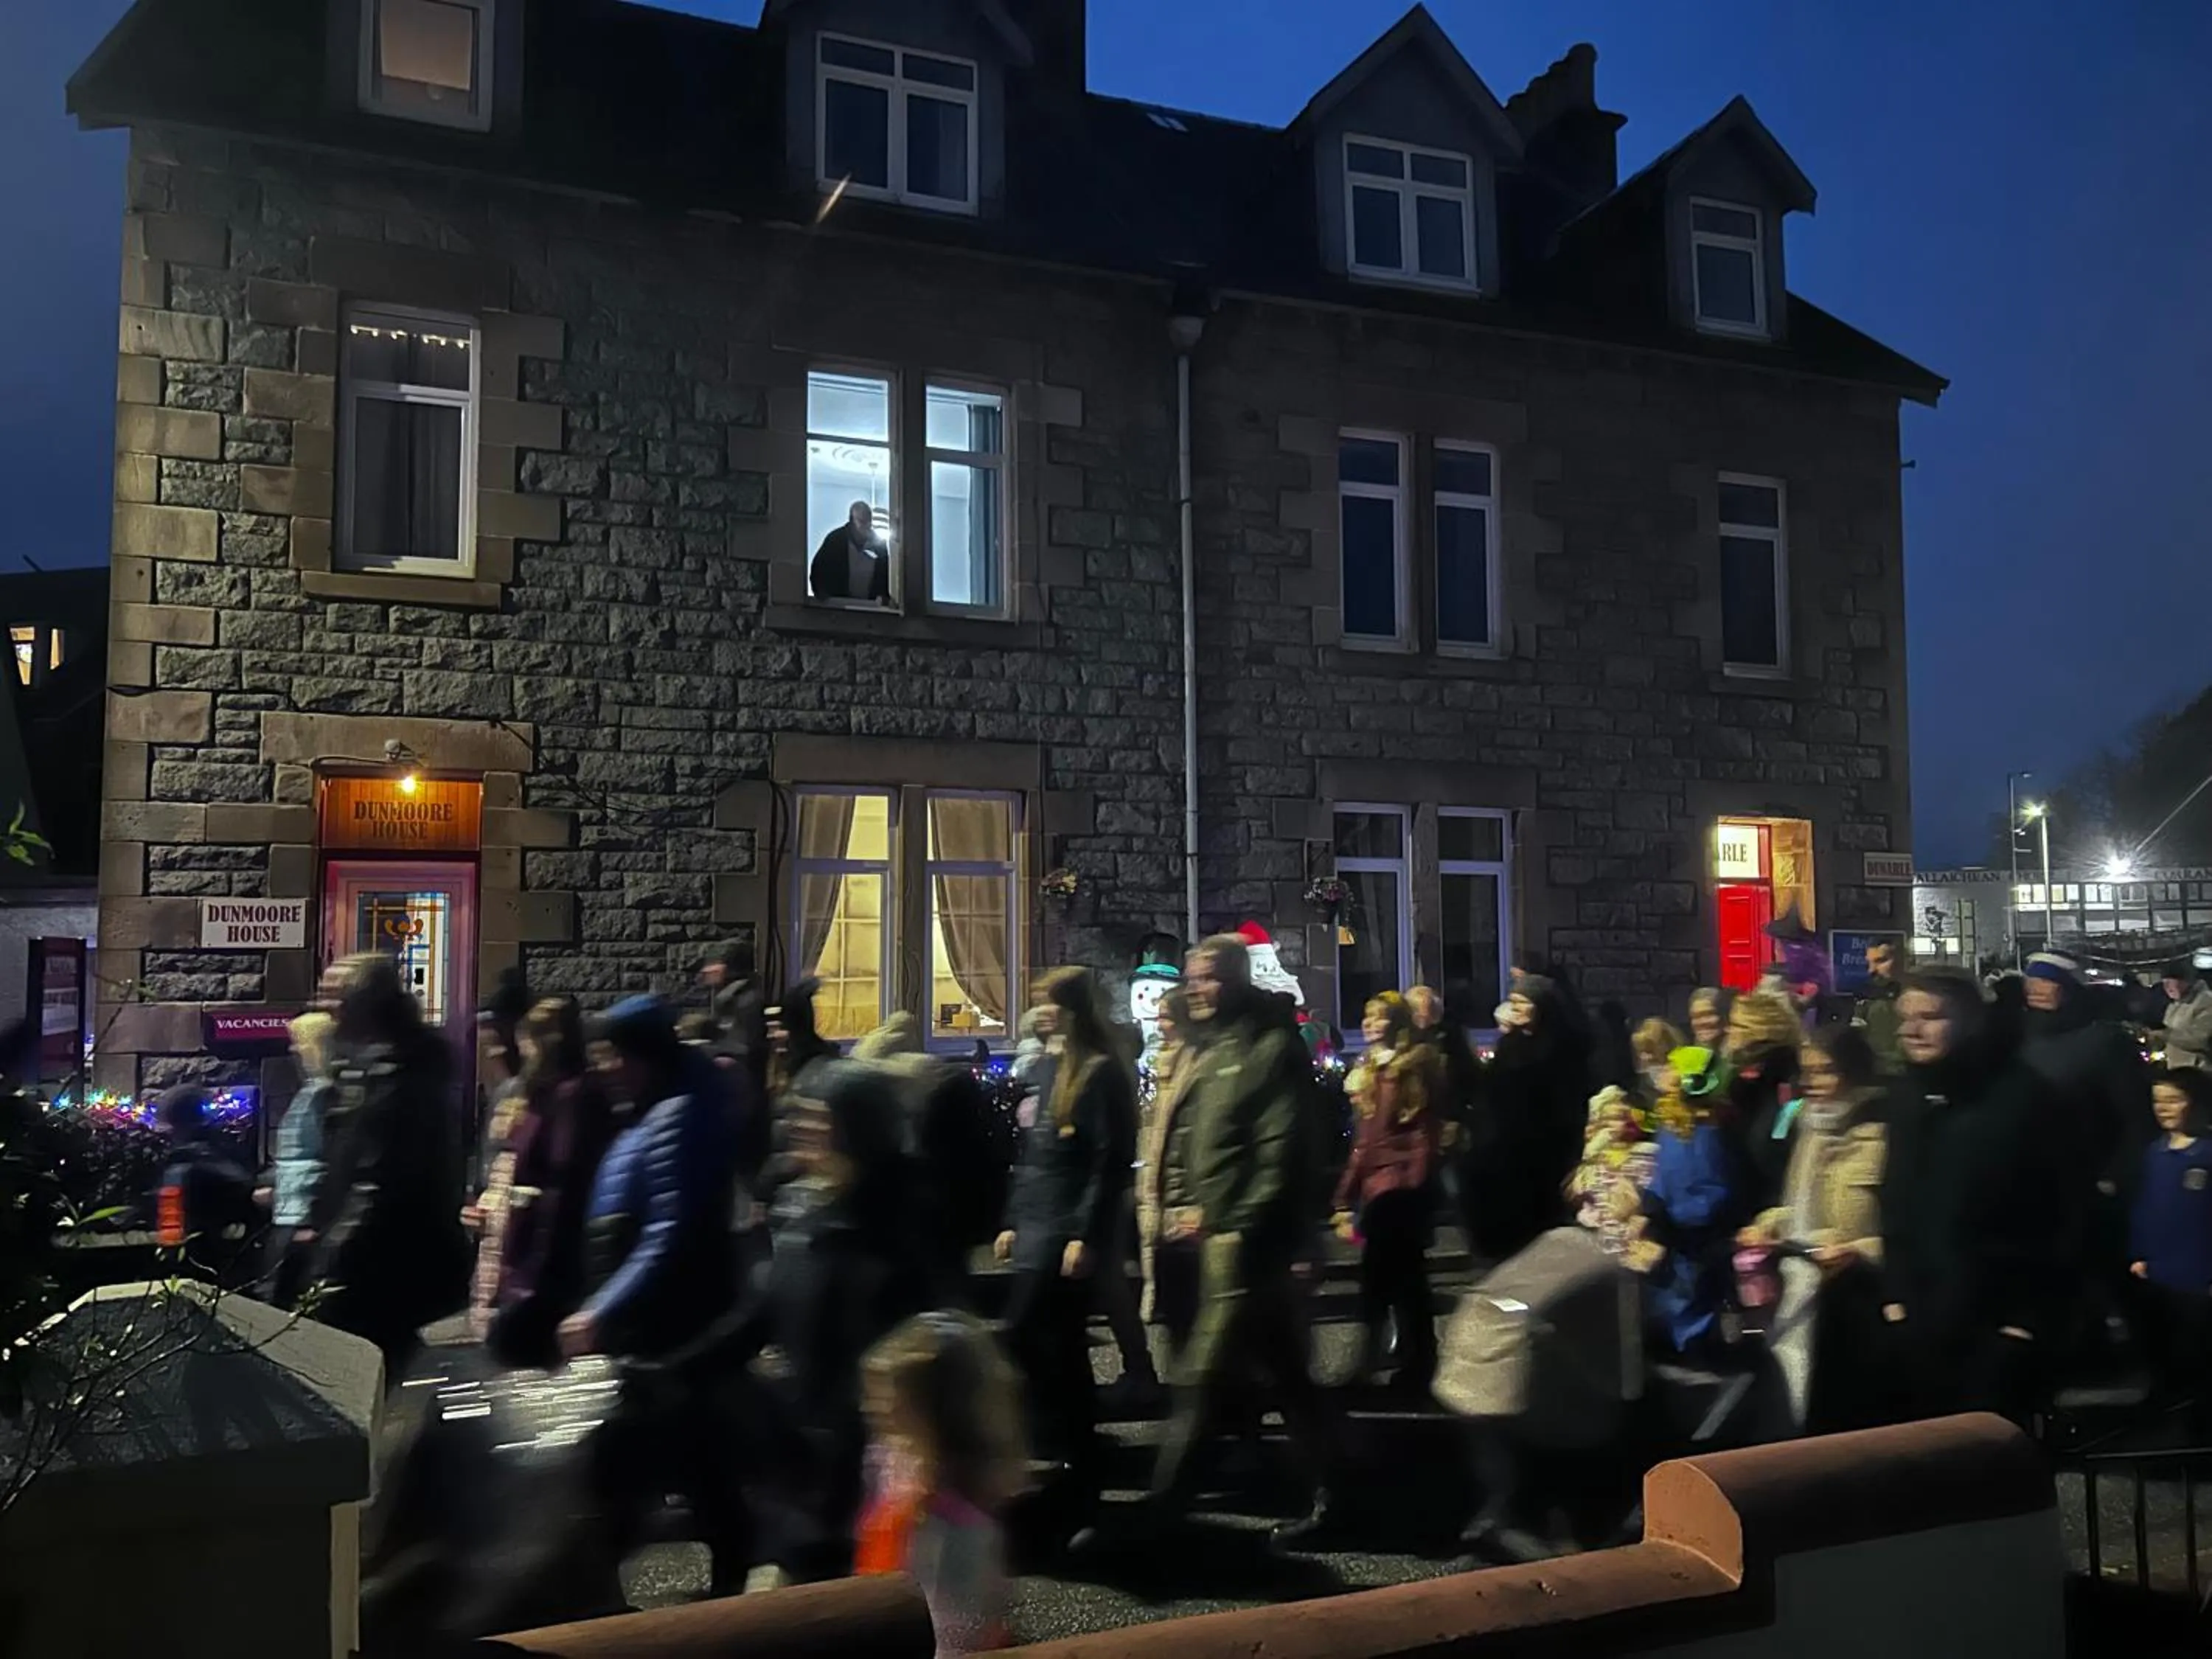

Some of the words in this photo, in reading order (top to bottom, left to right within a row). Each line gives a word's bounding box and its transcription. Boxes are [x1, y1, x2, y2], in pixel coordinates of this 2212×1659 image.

[354, 801, 452, 821] DUNMOORE
[372, 821, 428, 839] HOUSE
[1718, 843, 1747, 863] RLE
[1913, 872, 2000, 883] ALLAICHEAN
[207, 904, 301, 922] DUNMOORE
[227, 925, 281, 942] HOUSE
[217, 1018, 289, 1029] VACANCIES
